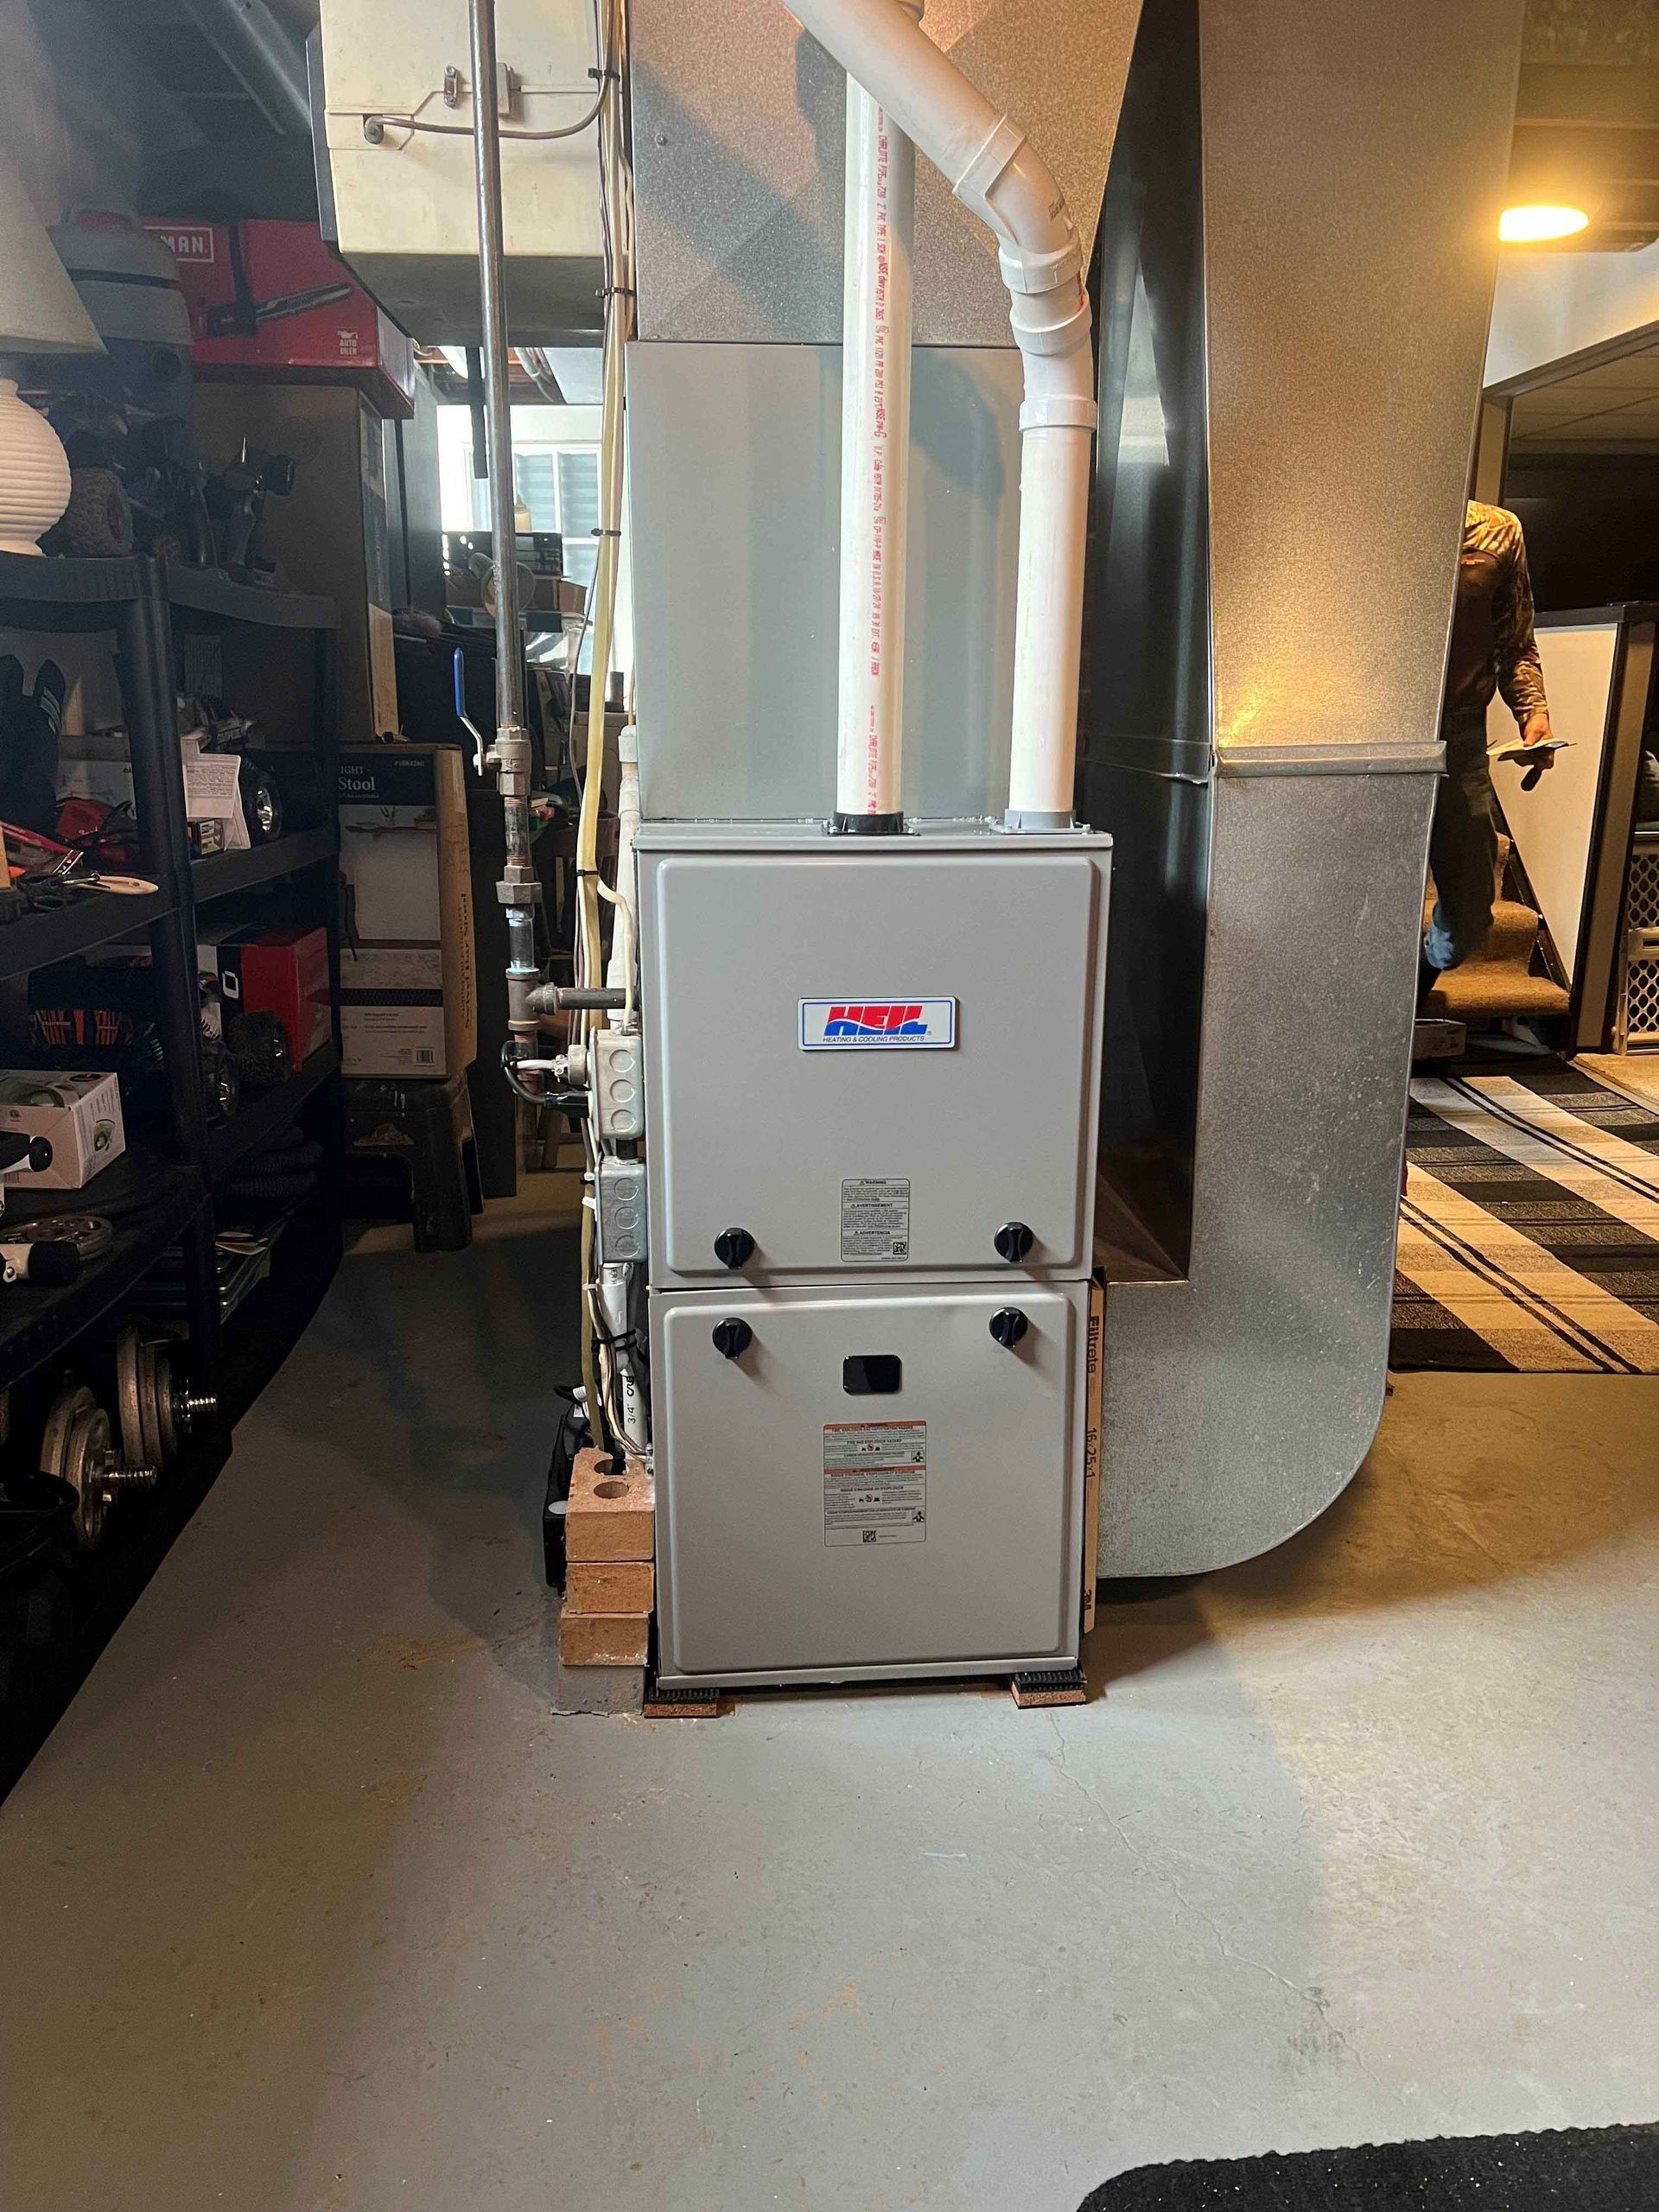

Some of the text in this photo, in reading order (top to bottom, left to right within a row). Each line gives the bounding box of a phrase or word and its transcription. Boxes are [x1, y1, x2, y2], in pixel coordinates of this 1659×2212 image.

[338, 776, 376, 791] Stool
[823, 1005, 929, 1036] HEIL
[1088, 1316, 1099, 1373] Filtrete
